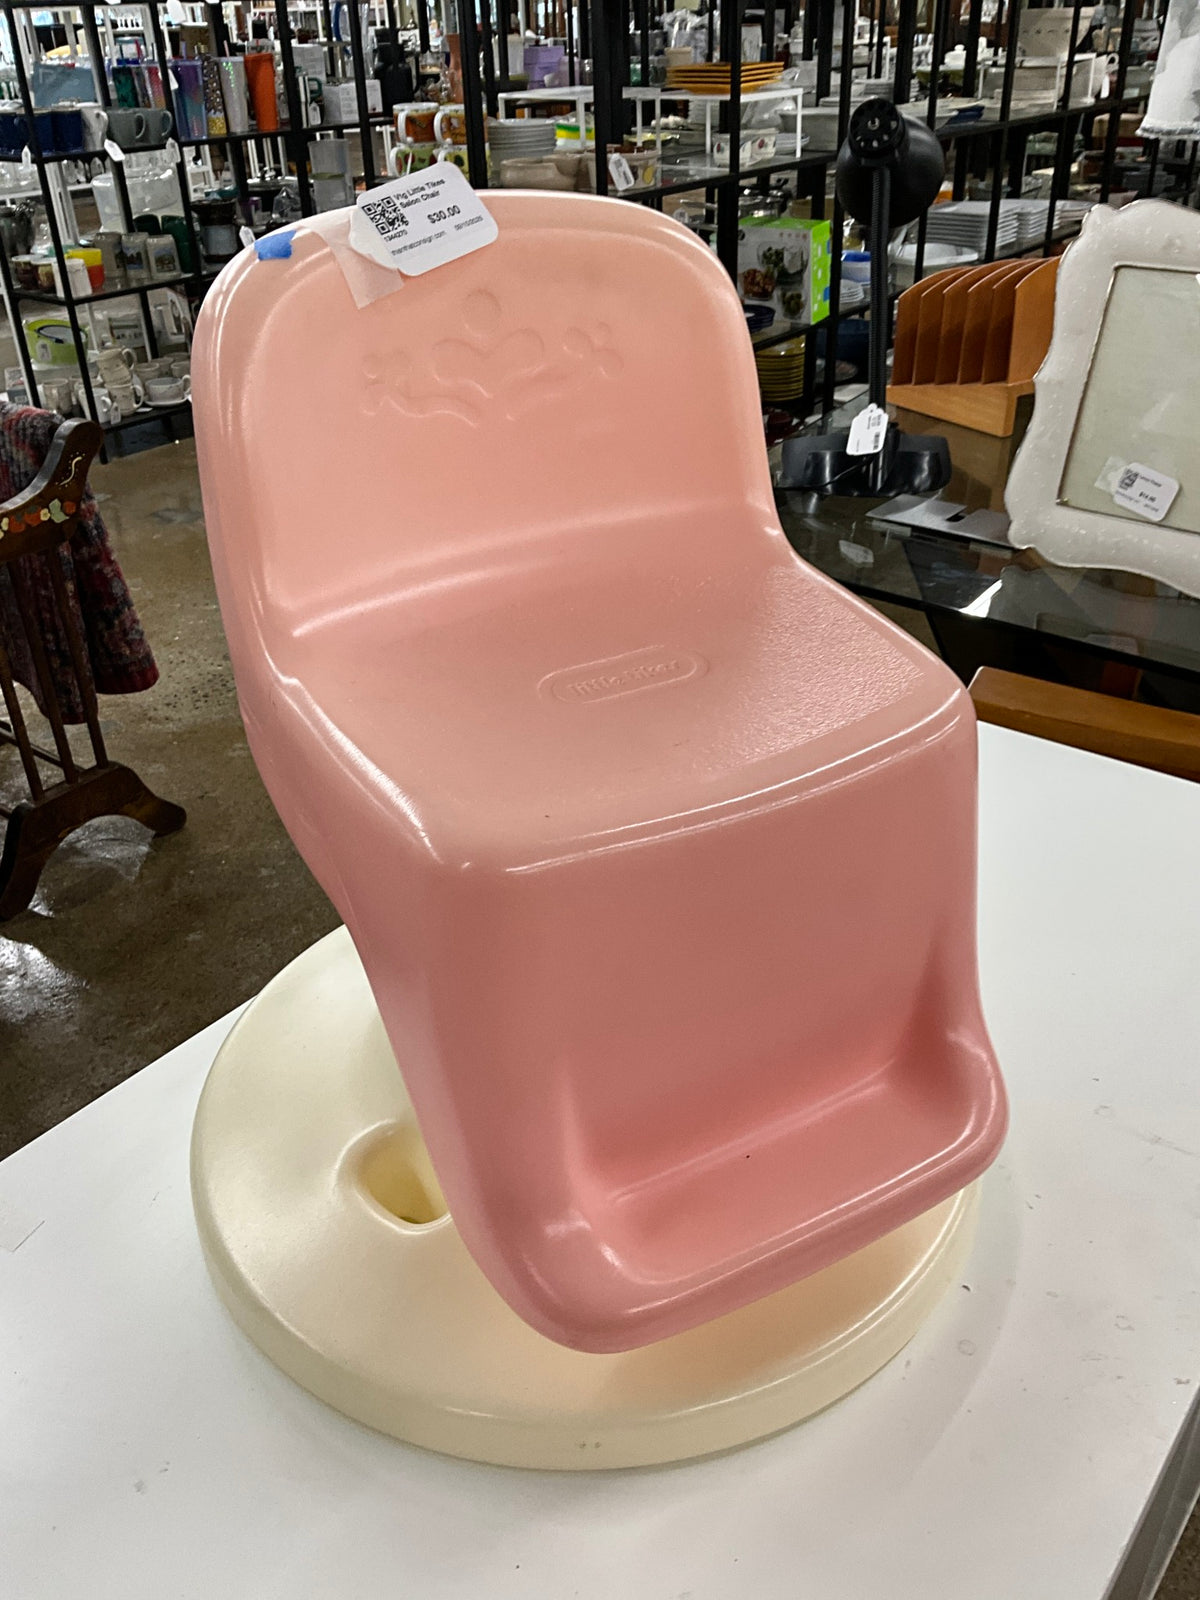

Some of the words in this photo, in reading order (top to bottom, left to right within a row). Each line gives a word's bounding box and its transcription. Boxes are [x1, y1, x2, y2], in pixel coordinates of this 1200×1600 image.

[399, 197, 421, 209] Salon
[420, 189, 440, 202] Chair
[407, 184, 426, 197] Little
[427, 205, 461, 223] $30.00
